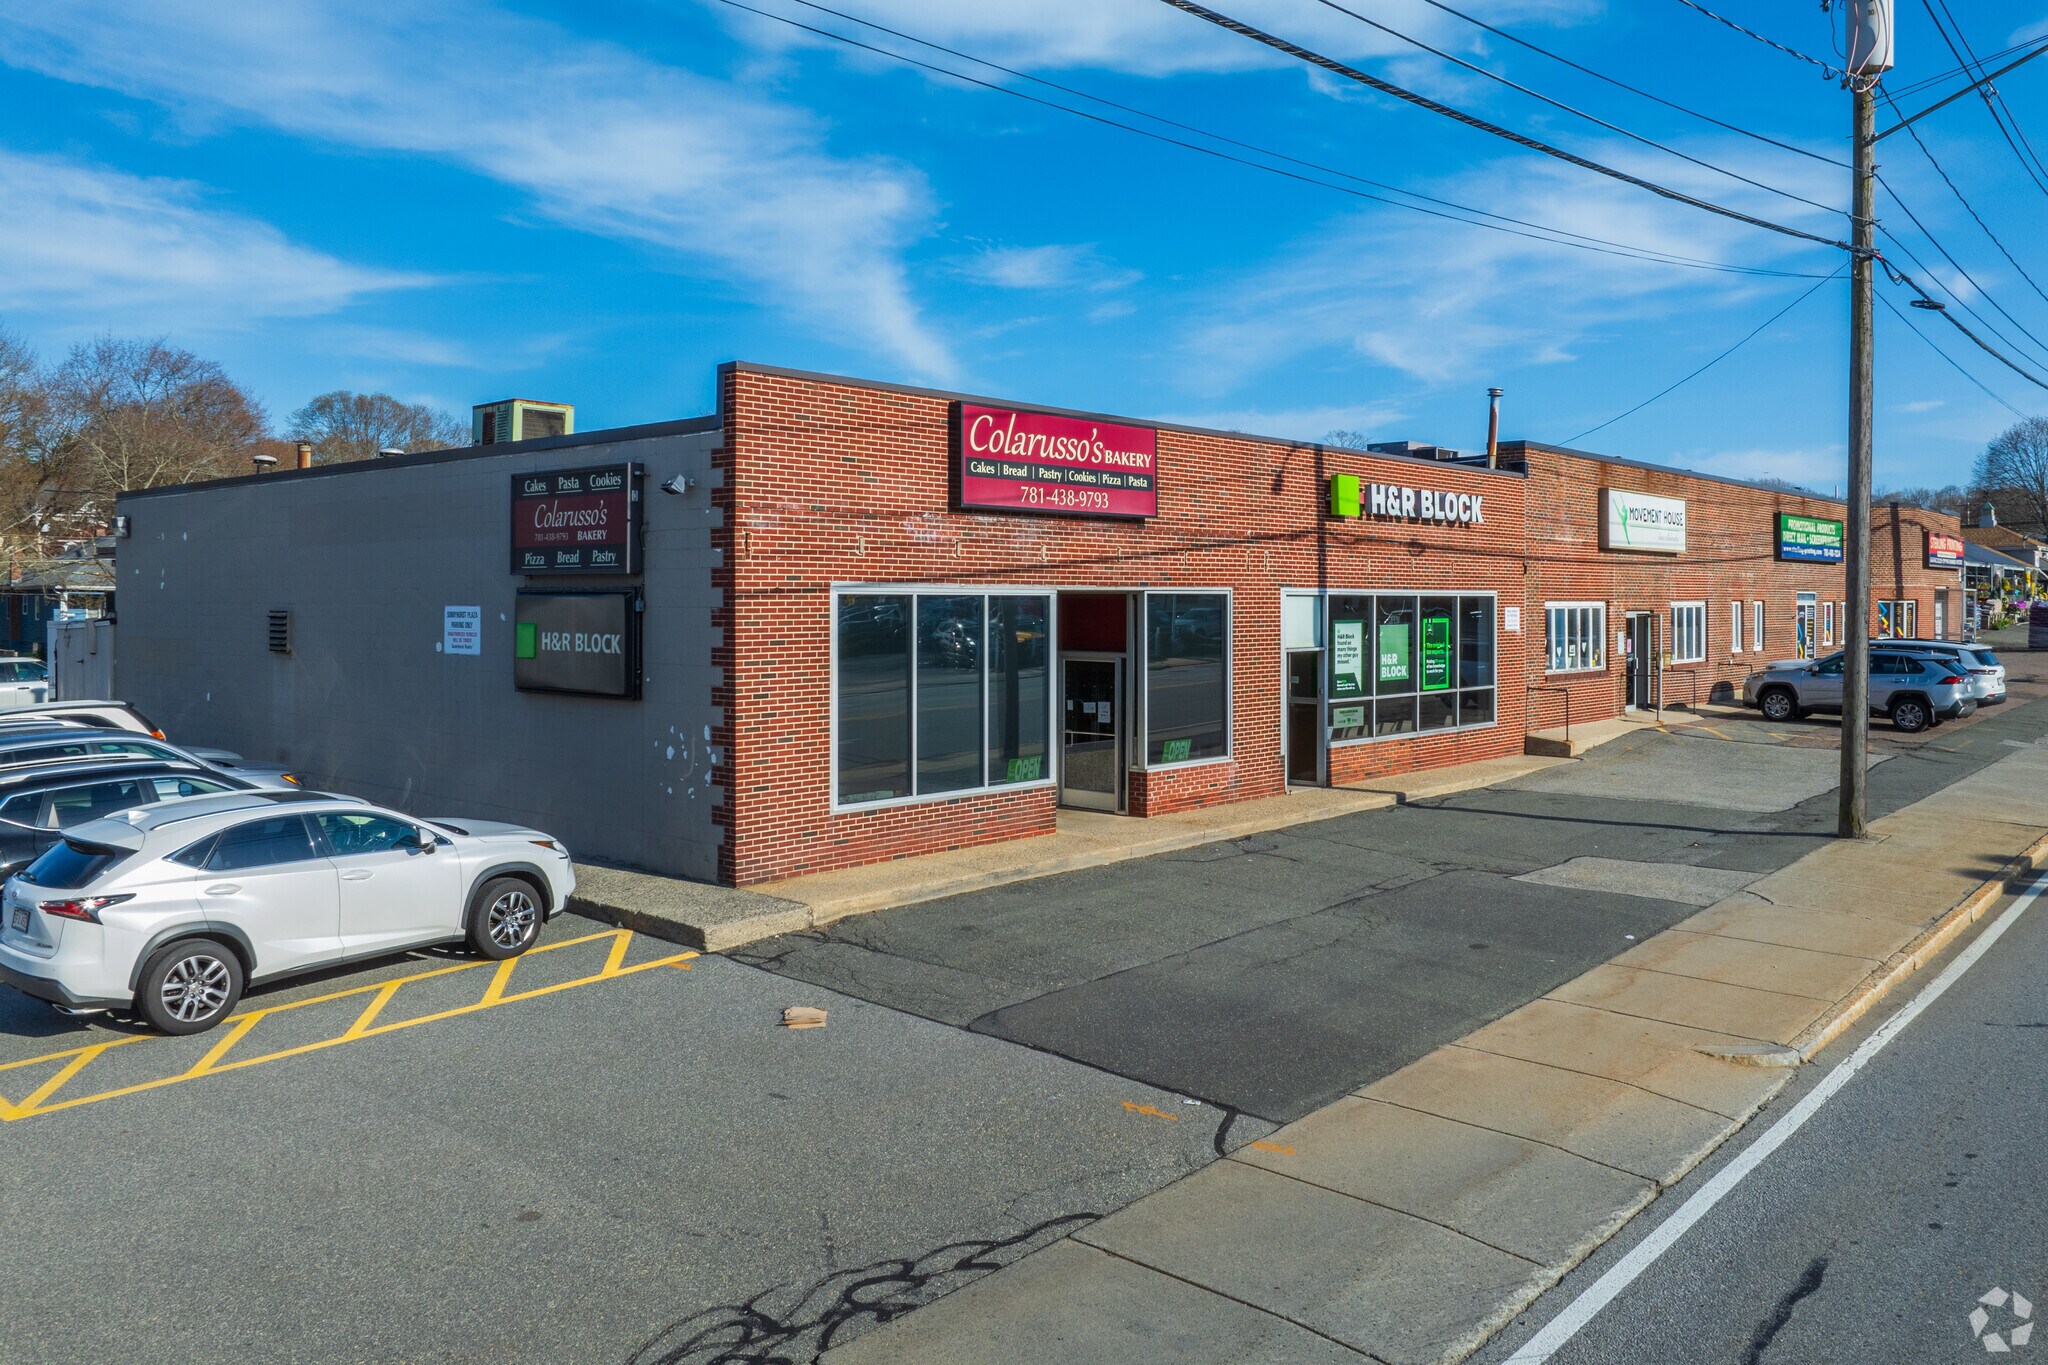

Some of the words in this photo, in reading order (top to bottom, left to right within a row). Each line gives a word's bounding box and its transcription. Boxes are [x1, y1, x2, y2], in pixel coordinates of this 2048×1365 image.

[969, 413, 1104, 464] Colarusso's
[1104, 450, 1152, 468] BAKERY
[524, 479, 547, 493] Cakes
[558, 477, 580, 490] Pasta
[590, 472, 622, 488] Cookies
[970, 461, 995, 475] Cakes
[1003, 464, 1028, 477] Bread
[1038, 467, 1062, 483] Pastry
[1069, 470, 1096, 484] Cookies
[1102, 474, 1122, 486] Pizza
[1128, 476, 1148, 488] Pasta
[1020, 486, 1109, 509] 781-438-9793
[1368, 483, 1416, 518] H&R
[1420, 489, 1484, 524] BLOCK
[534, 499, 608, 529] Colarusso's
[1629, 507, 1662, 524] MOVEMENT
[1664, 510, 1684, 527] HOUSE
[534, 532, 569, 542] 781-438-9793
[577, 530, 608, 541] BAKERY
[1782, 531, 1796, 543] DIRECT
[1788, 519, 1816, 533] PROMOTIONAL
[1816, 522, 1836, 535] PRODUCTS
[524, 552, 545, 565] Pizza
[557, 550, 580, 564] Bread
[592, 550, 616, 565] Pastry
[541, 632, 571, 652] H&R
[575, 633, 622, 655] BLOCK
[1381, 654, 1398, 665] H&R
[1381, 666, 1407, 678] BLOCK
[1168, 741, 1191, 761] OPEN
[1014, 756, 1041, 782] OPEN
